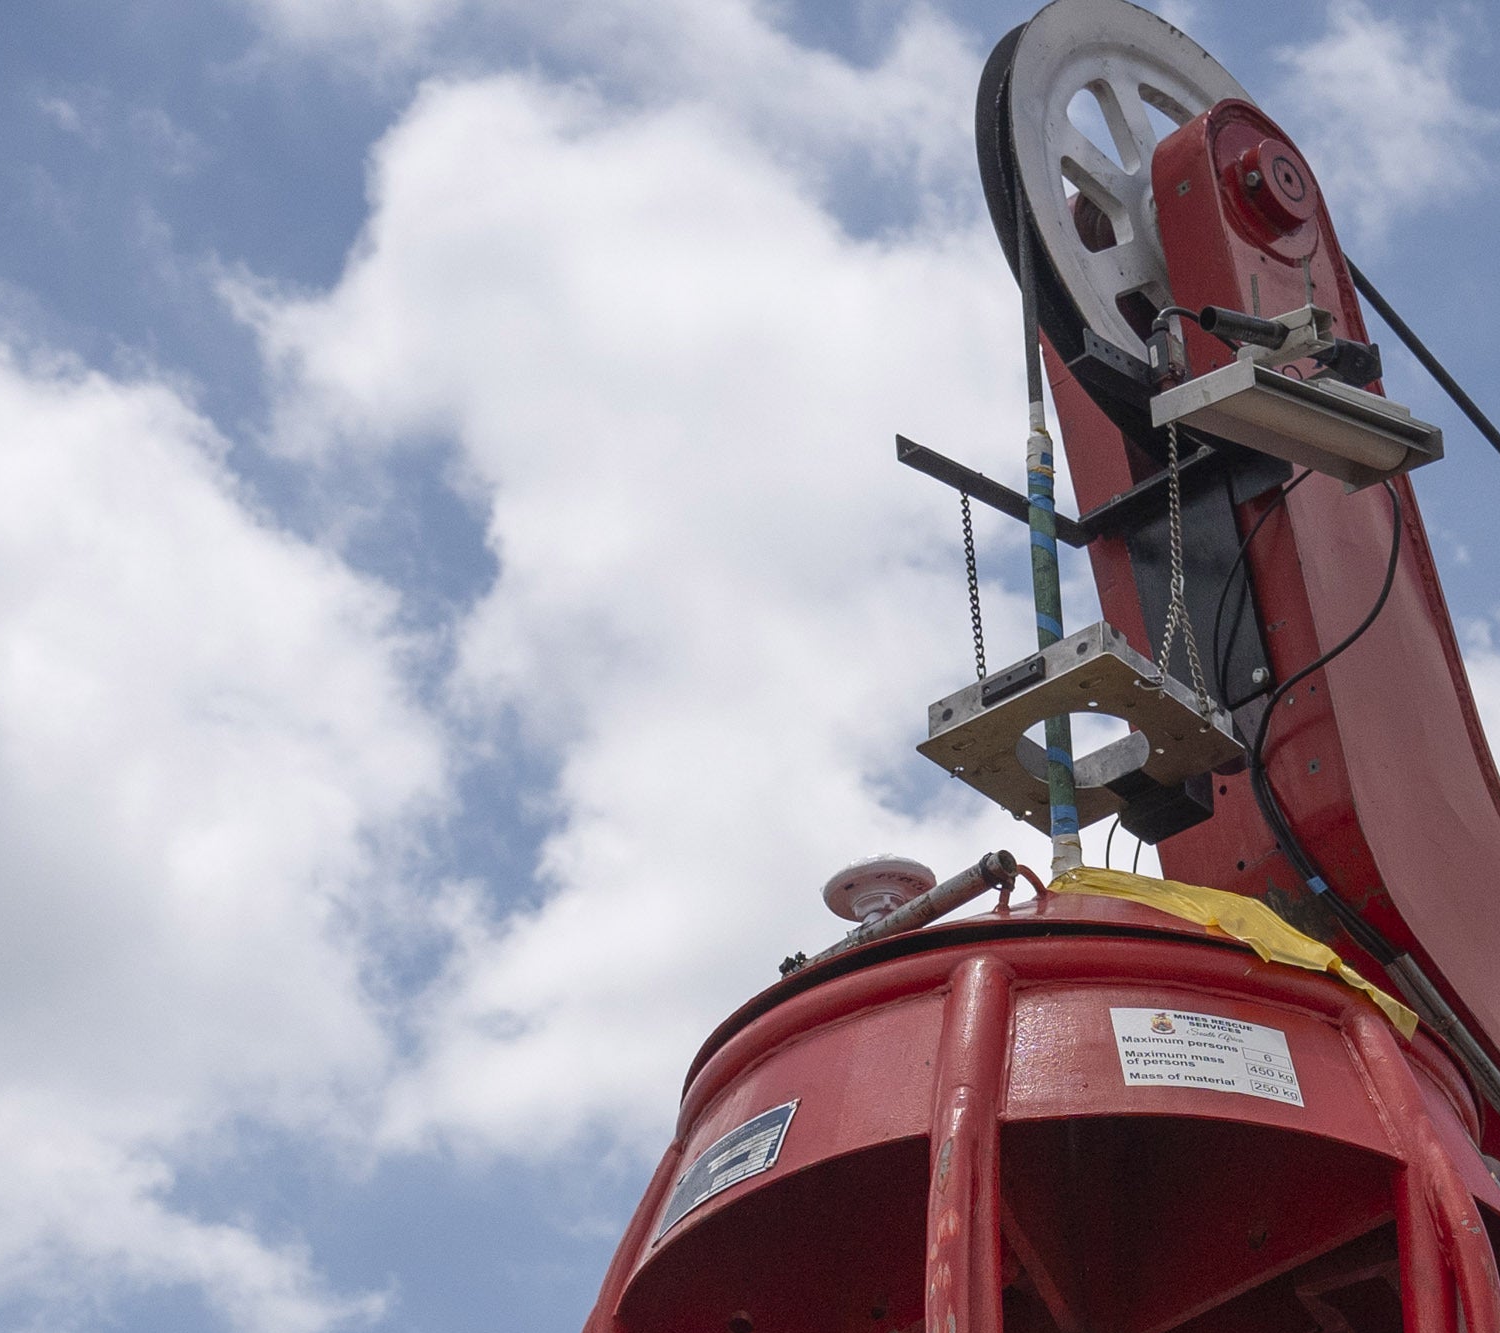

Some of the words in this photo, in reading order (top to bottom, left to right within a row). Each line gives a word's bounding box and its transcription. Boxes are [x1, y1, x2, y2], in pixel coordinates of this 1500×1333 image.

[1173, 1014, 1208, 1023] MINES
[1211, 1018, 1253, 1032] RESCUE
[1188, 1021, 1242, 1035] SERVICES
[1186, 1028, 1216, 1039] South
[1122, 1035, 1184, 1045] Maximum
[1188, 1039, 1239, 1053] persons
[1264, 1054, 1272, 1063] 6
[1125, 1050, 1187, 1060] Maximum
[1191, 1054, 1225, 1064] mass
[1126, 1058, 1141, 1066] of
[1143, 1059, 1196, 1068] persons
[1250, 1064, 1275, 1078] 450
[1278, 1071, 1294, 1083] kg
[1129, 1071, 1164, 1080] Mass
[1167, 1072, 1181, 1080] of
[1184, 1075, 1236, 1087] material
[1254, 1081, 1279, 1095] 250
[1282, 1088, 1298, 1101] kg
